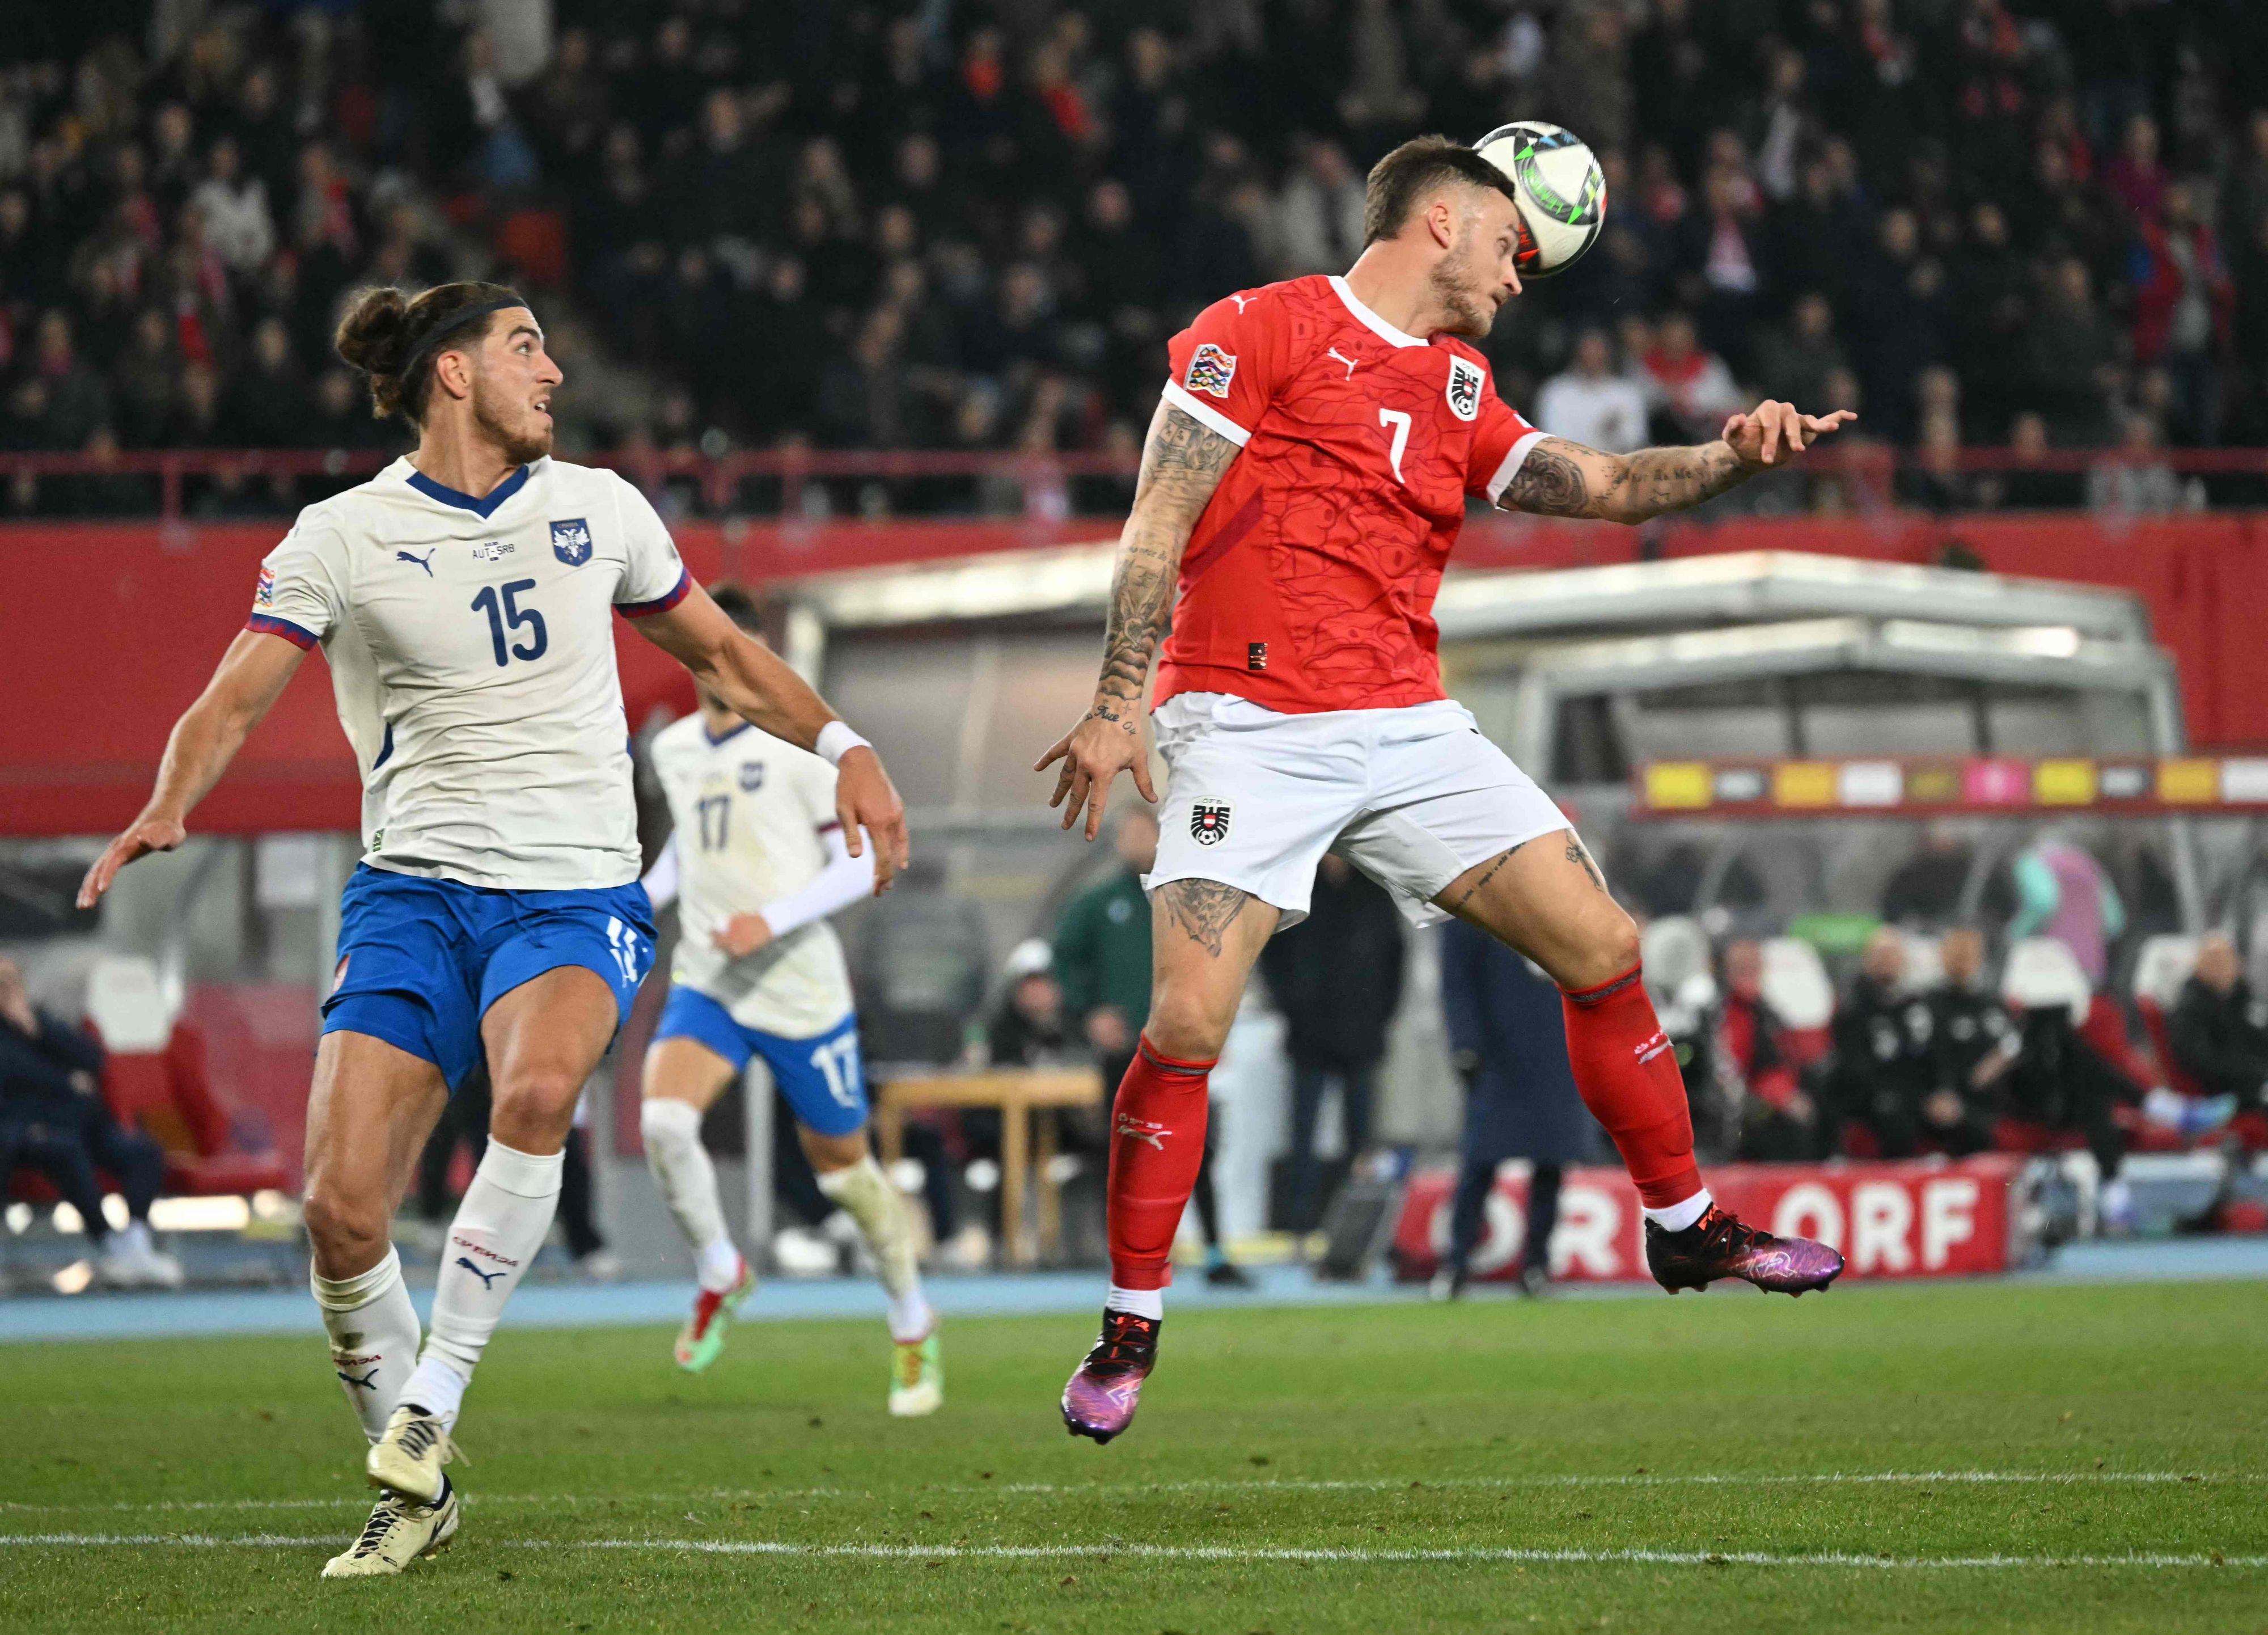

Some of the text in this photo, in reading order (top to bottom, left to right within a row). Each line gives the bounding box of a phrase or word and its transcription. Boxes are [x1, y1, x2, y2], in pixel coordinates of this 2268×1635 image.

[1379, 408, 1412, 484] 7
[471, 578, 548, 667] 15
[696, 795, 730, 850] 17
[810, 1030, 861, 1109] 17
[1771, 1178, 1979, 1273] ORF
